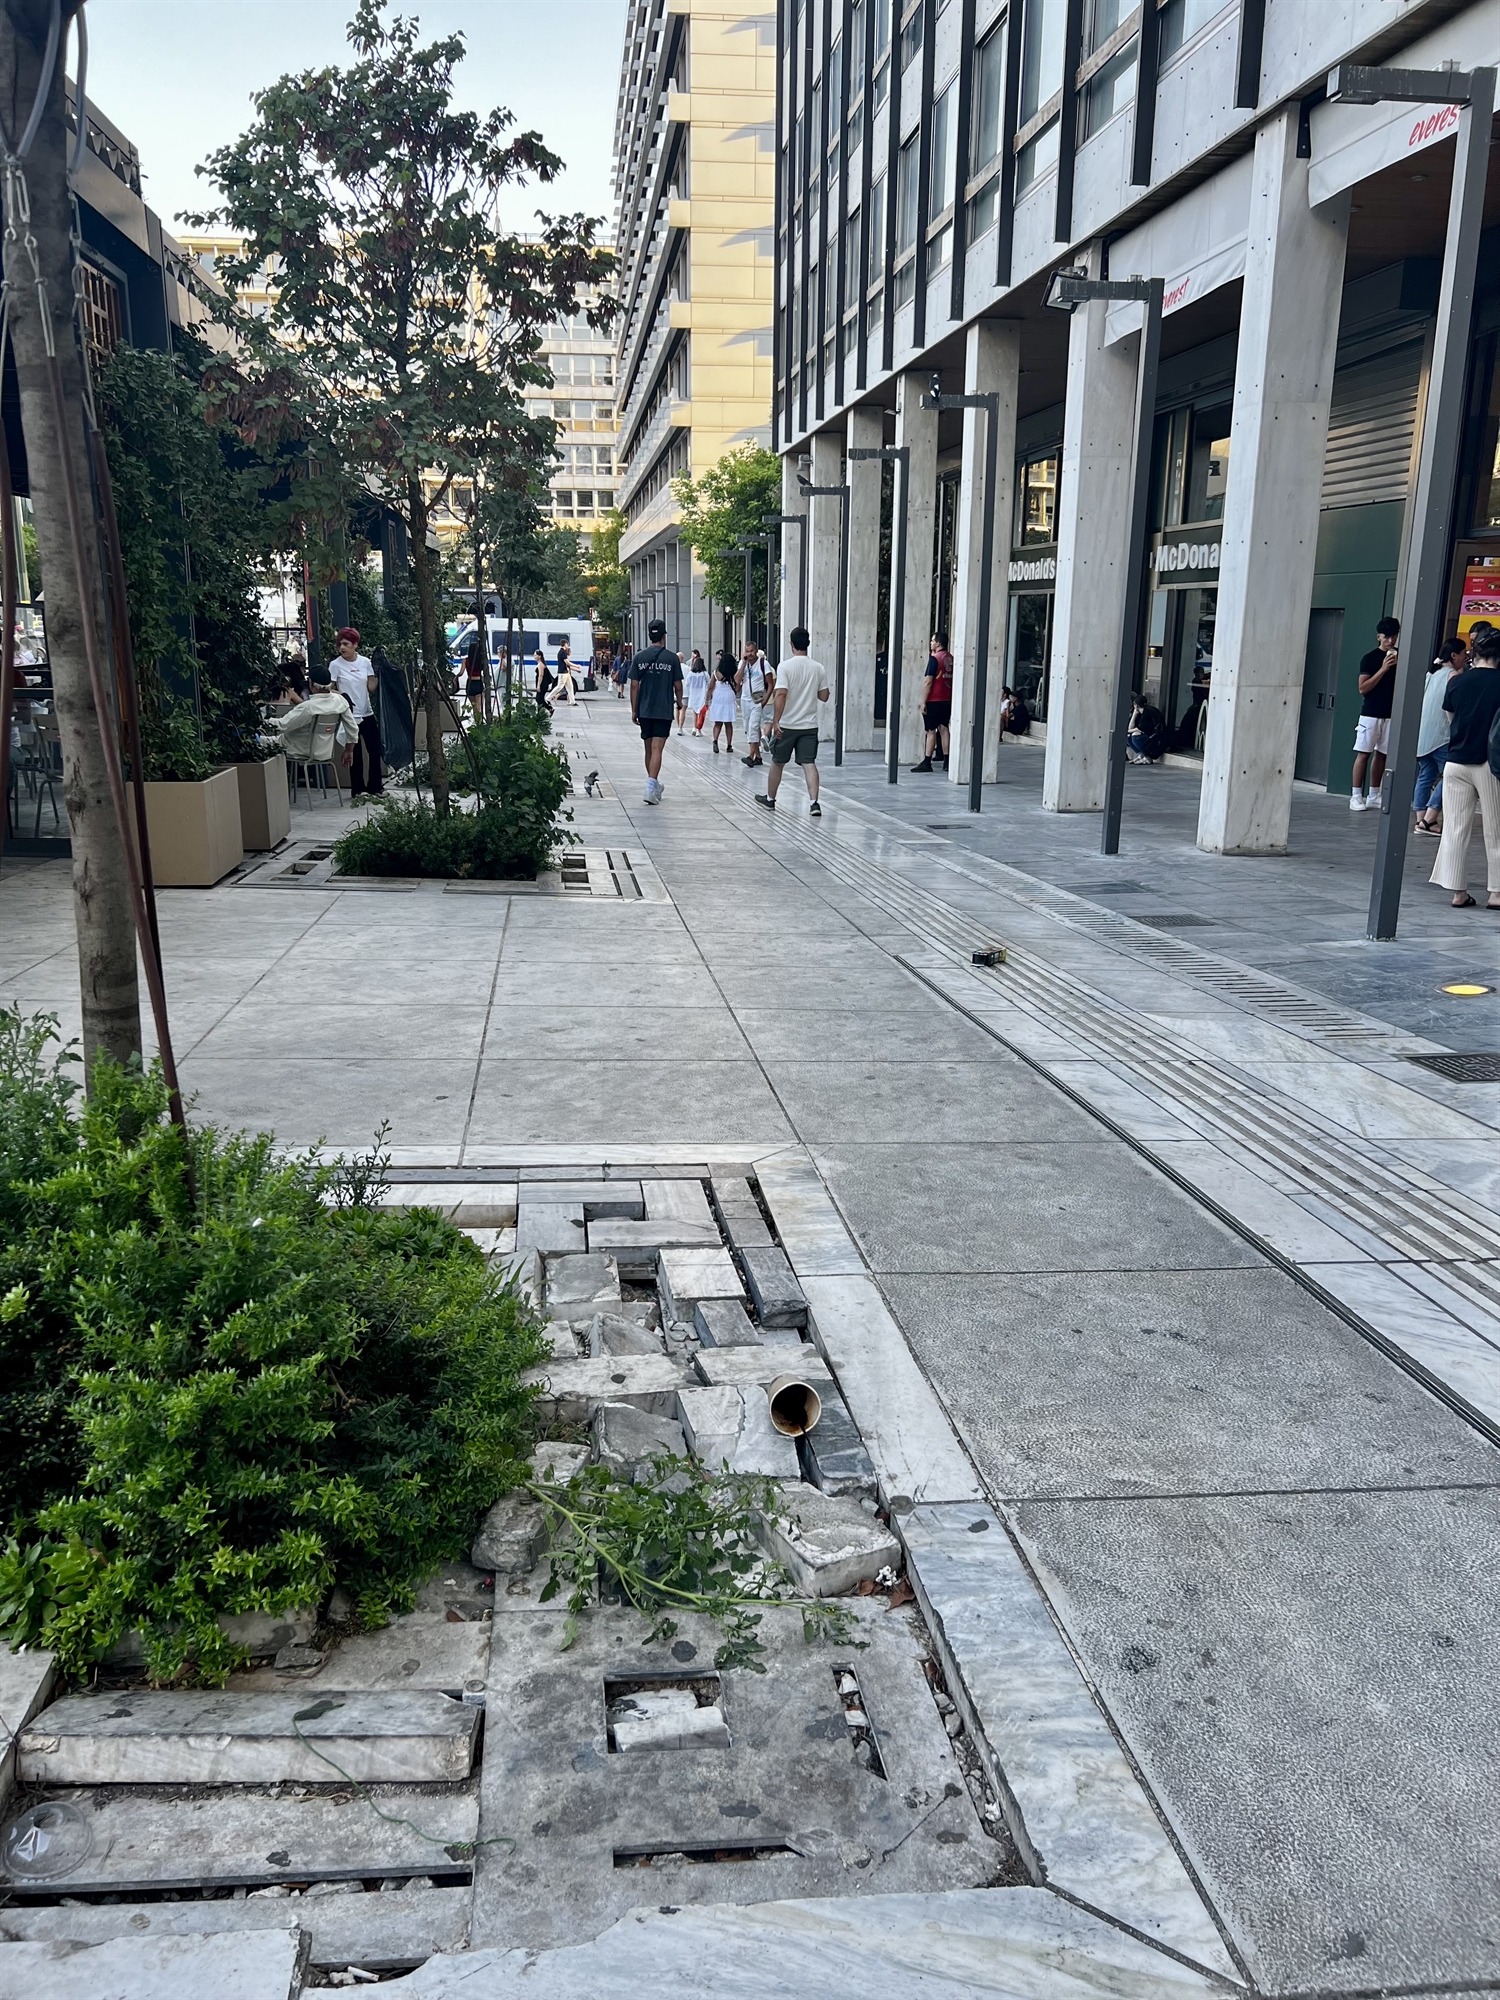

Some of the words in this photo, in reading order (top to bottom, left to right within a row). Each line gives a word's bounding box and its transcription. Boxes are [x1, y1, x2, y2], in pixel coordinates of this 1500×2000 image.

[1408, 104, 1460, 147] everes
[1162, 275, 1191, 311] verest
[1154, 542, 1220, 572] McDona
